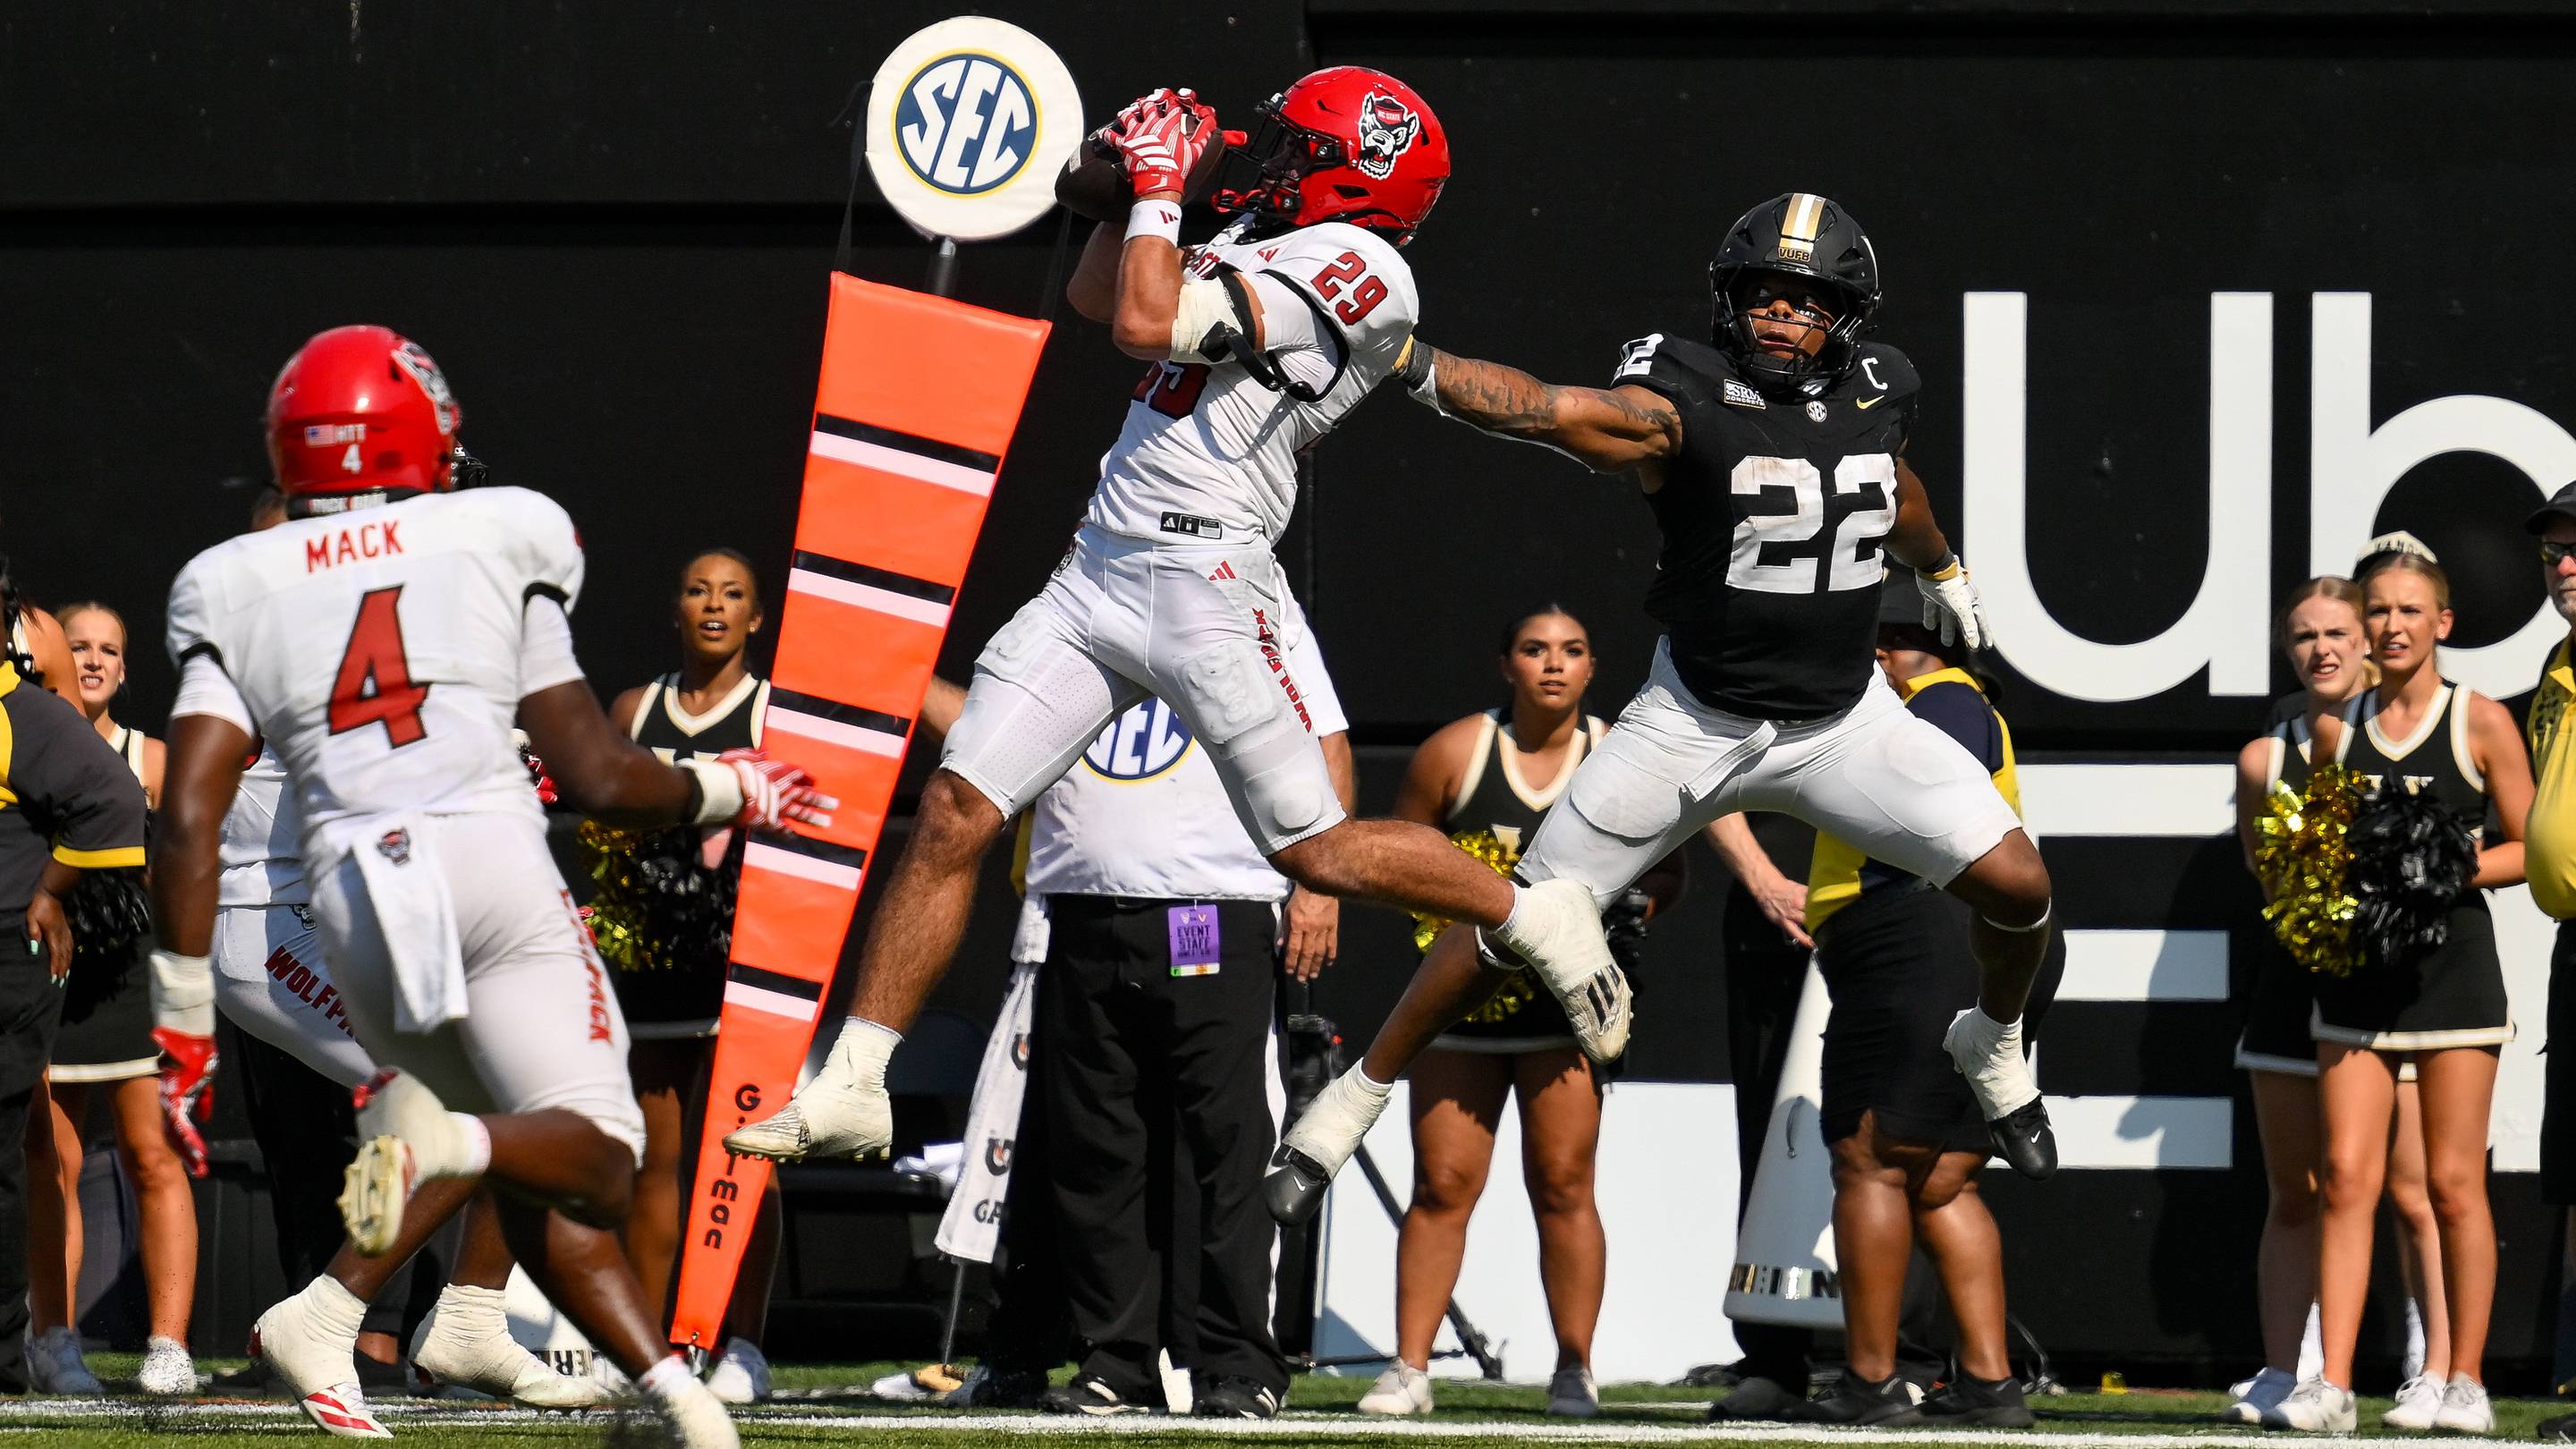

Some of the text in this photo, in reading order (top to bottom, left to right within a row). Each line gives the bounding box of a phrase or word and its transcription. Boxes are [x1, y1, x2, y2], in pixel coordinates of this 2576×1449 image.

[902, 59, 1030, 189] SEC
[1779, 248, 1810, 262] VUFB
[1310, 251, 1388, 326] 29
[1861, 357, 1888, 390] C
[342, 444, 362, 474] 4
[1725, 453, 1897, 594] 22
[305, 520, 403, 573] MACK
[326, 583, 429, 749] 4
[1177, 925, 1210, 937] EVENT
[1179, 937, 1210, 949] STAFF
